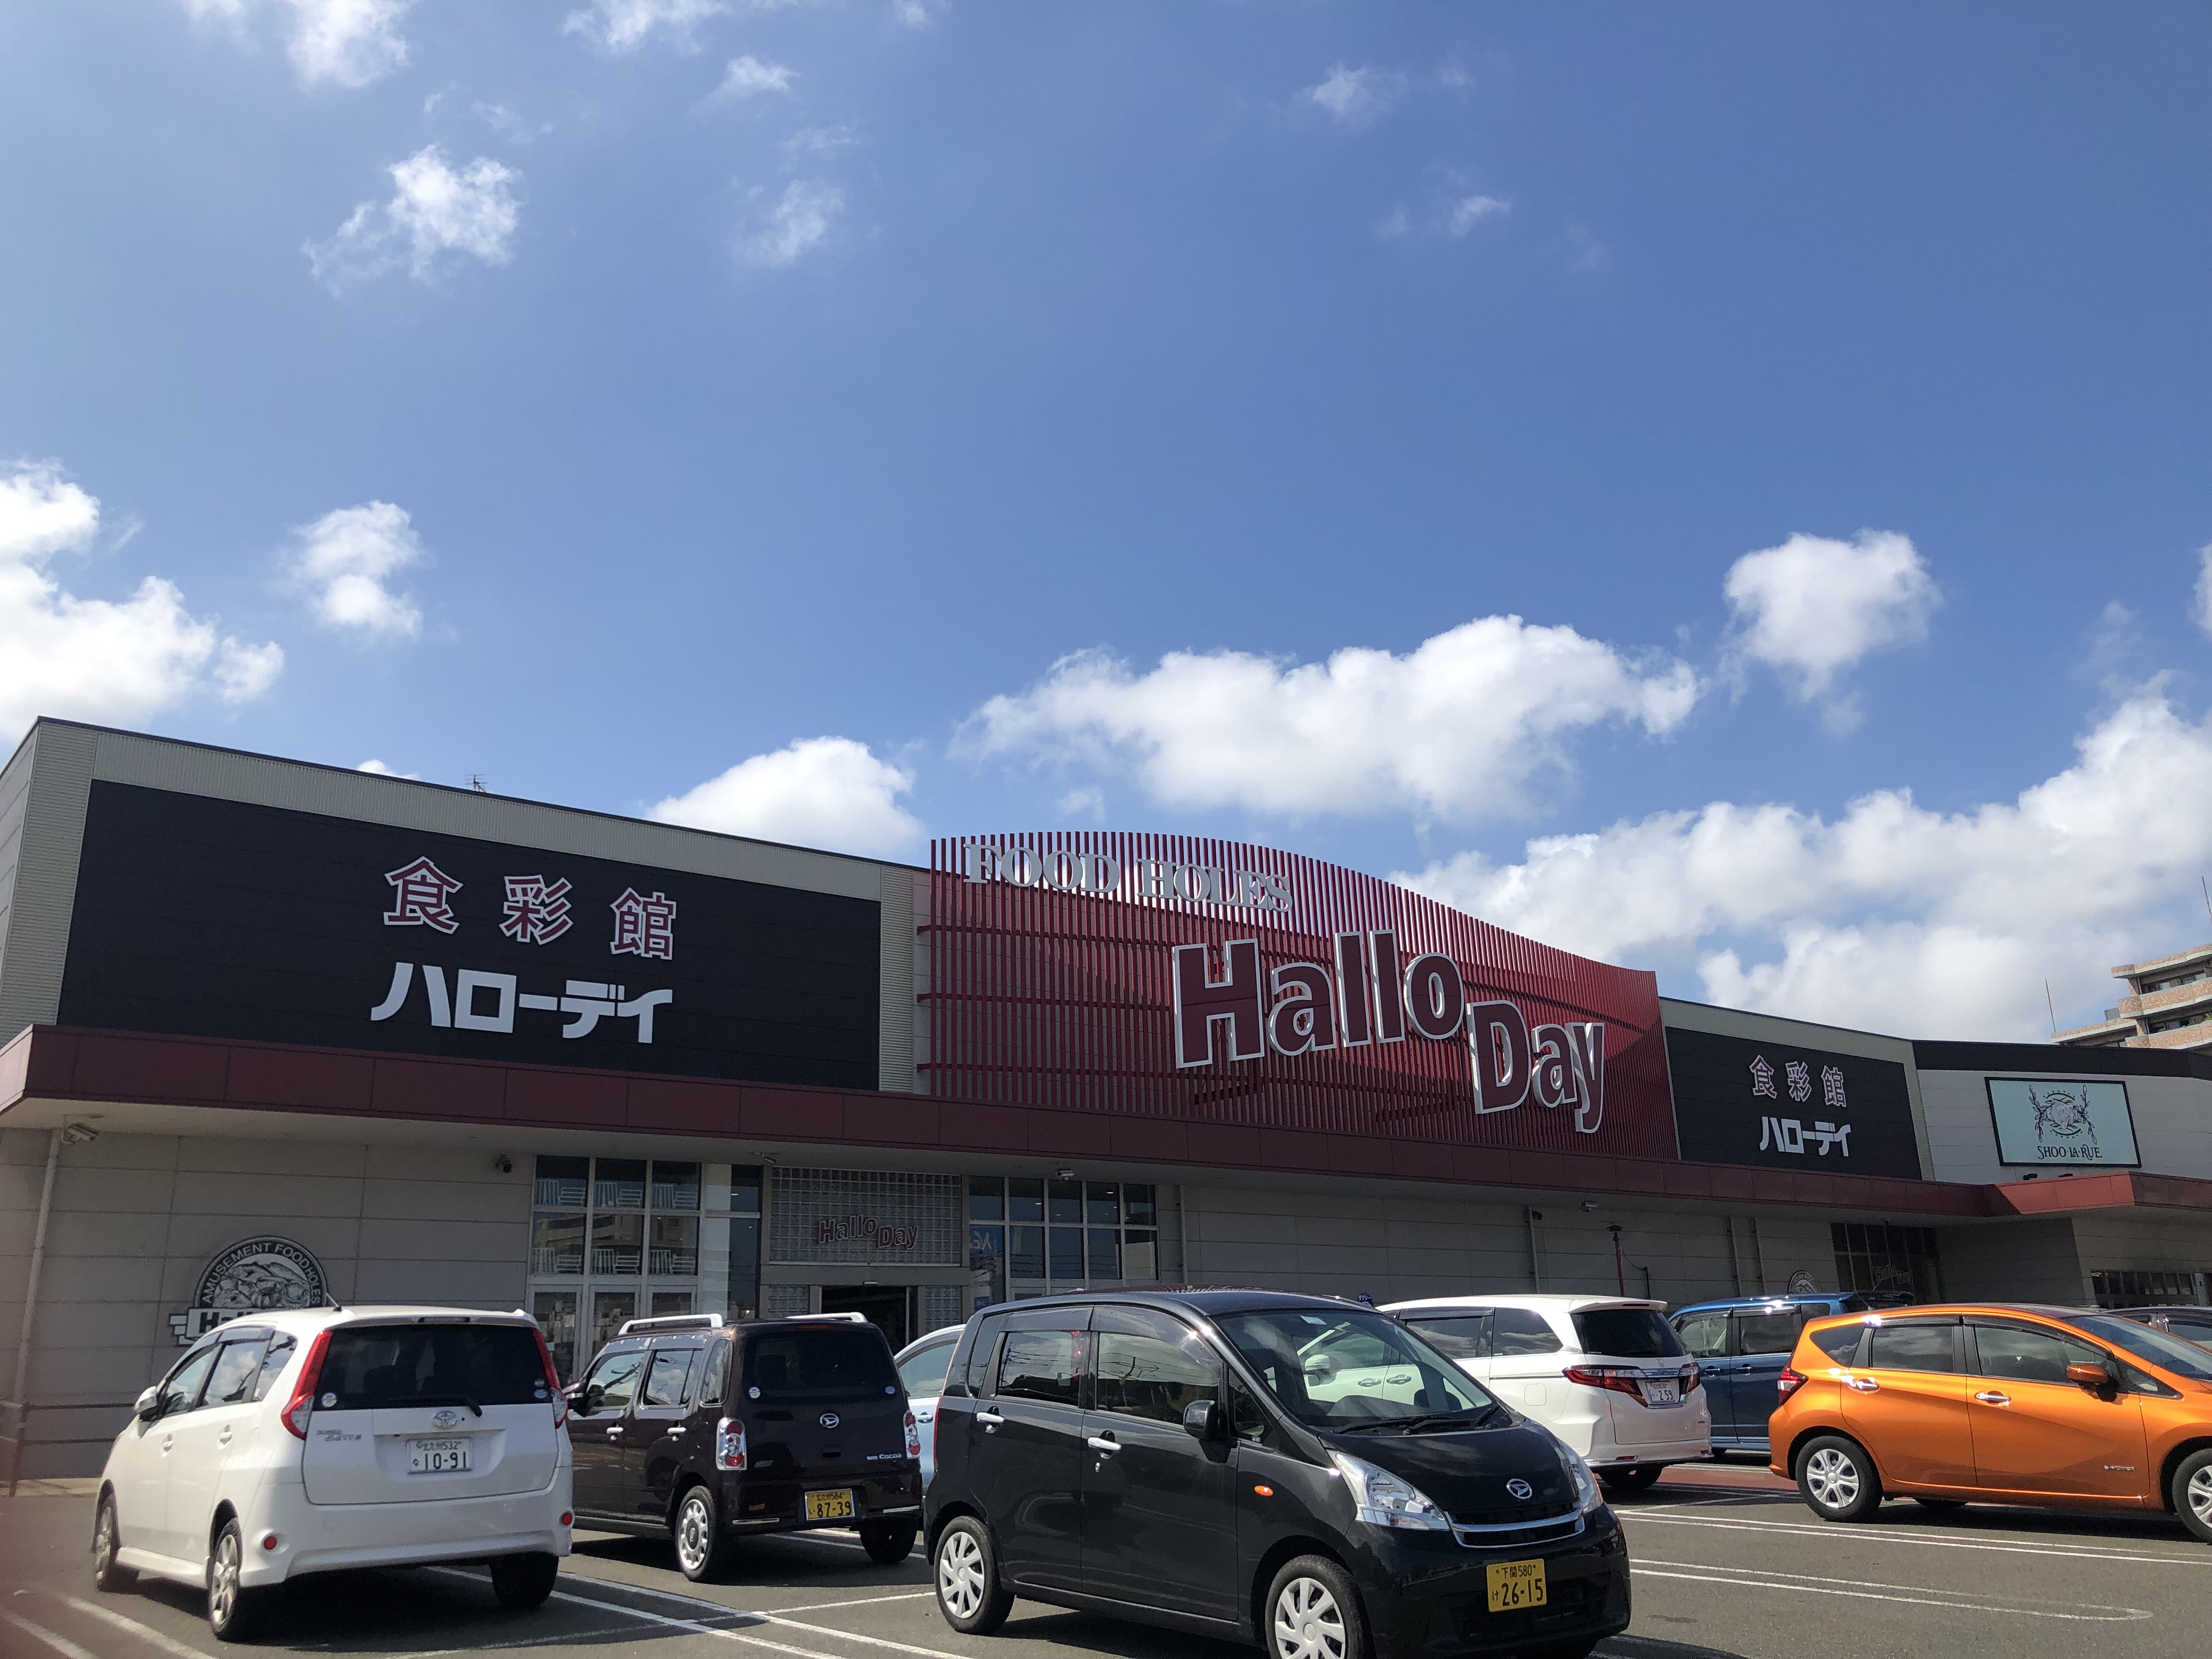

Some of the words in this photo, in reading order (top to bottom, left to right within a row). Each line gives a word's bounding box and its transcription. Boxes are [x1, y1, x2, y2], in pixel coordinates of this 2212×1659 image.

[963, 843, 1120, 894] FOOD
[1136, 858, 1293, 913] HOLES
[384, 856, 676, 961] 食彩館
[371, 962, 673, 1043] ハローディ
[1172, 929, 1464, 1069] Hallo
[1466, 1000, 1605, 1133] Day
[1749, 1054, 1847, 1107] 食彩館
[1759, 1116, 1851, 1157] ハローディ
[818, 1215, 877, 1244] Hallo
[878, 1225, 919, 1250] Day
[202, 1242, 272, 1304] AMUSEMENT
[425, 1451, 466, 1470] 10-91
[817, 1501, 851, 1517] 87-39
[1492, 1590, 1499, 1601] け
[1501, 1578, 1543, 1606] 26-15
